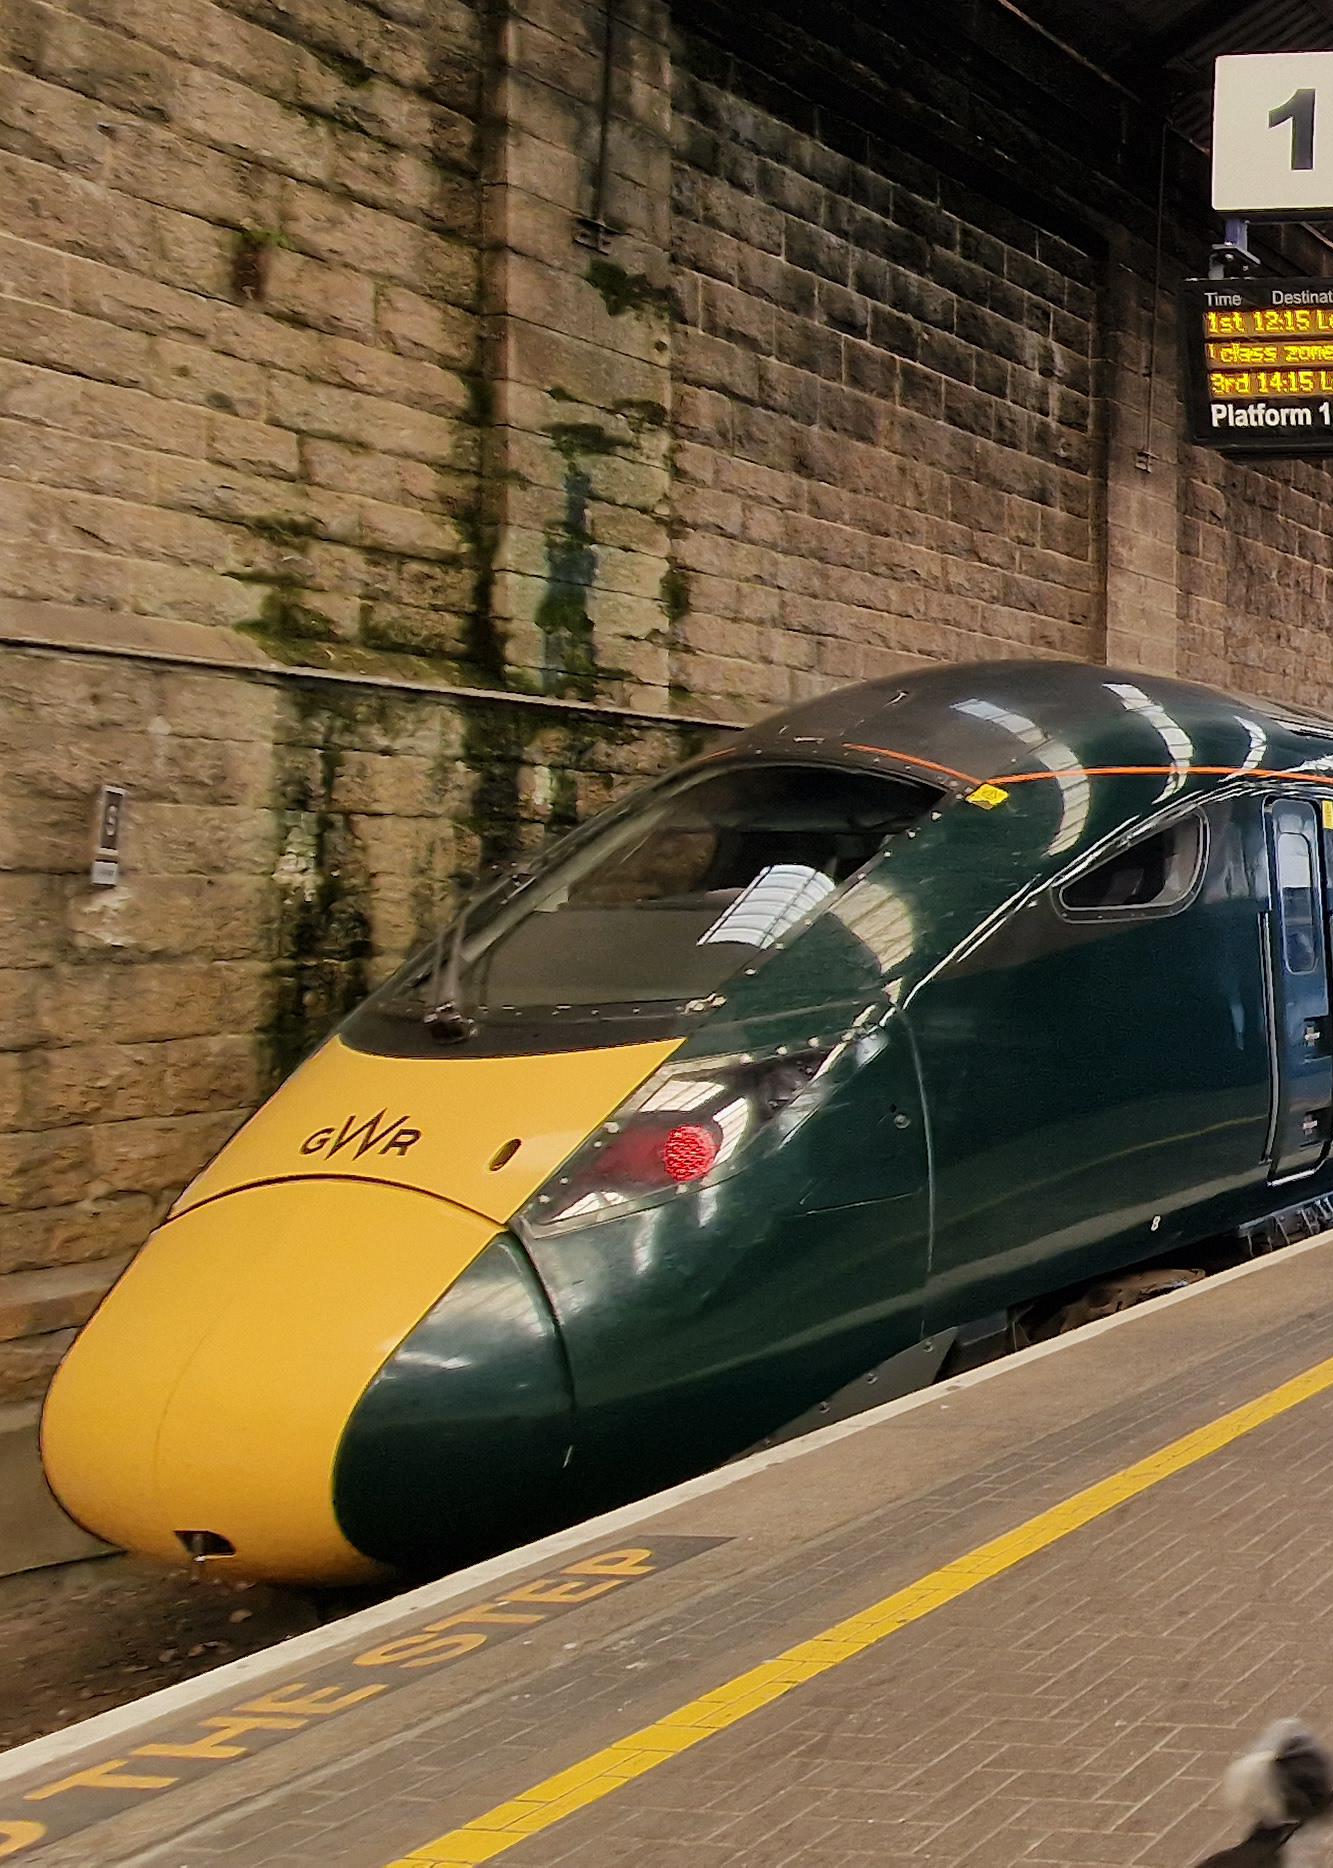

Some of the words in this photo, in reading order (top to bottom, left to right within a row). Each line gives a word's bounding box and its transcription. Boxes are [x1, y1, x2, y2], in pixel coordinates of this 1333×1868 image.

[1268, 88, 1316, 170] 1
[1204, 292, 1243, 307] Time
[1207, 311, 1246, 333] 1st
[1253, 309, 1311, 332] 12:15
[1210, 373, 1250, 394] 3rd
[1256, 371, 1315, 394] 14:15
[1210, 402, 1312, 428] Platform
[1318, 401, 1331, 426] 1
[300, 1107, 422, 1161] GWR
[24, 1683, 389, 1801] THE
[352, 1547, 657, 1669] STEP
